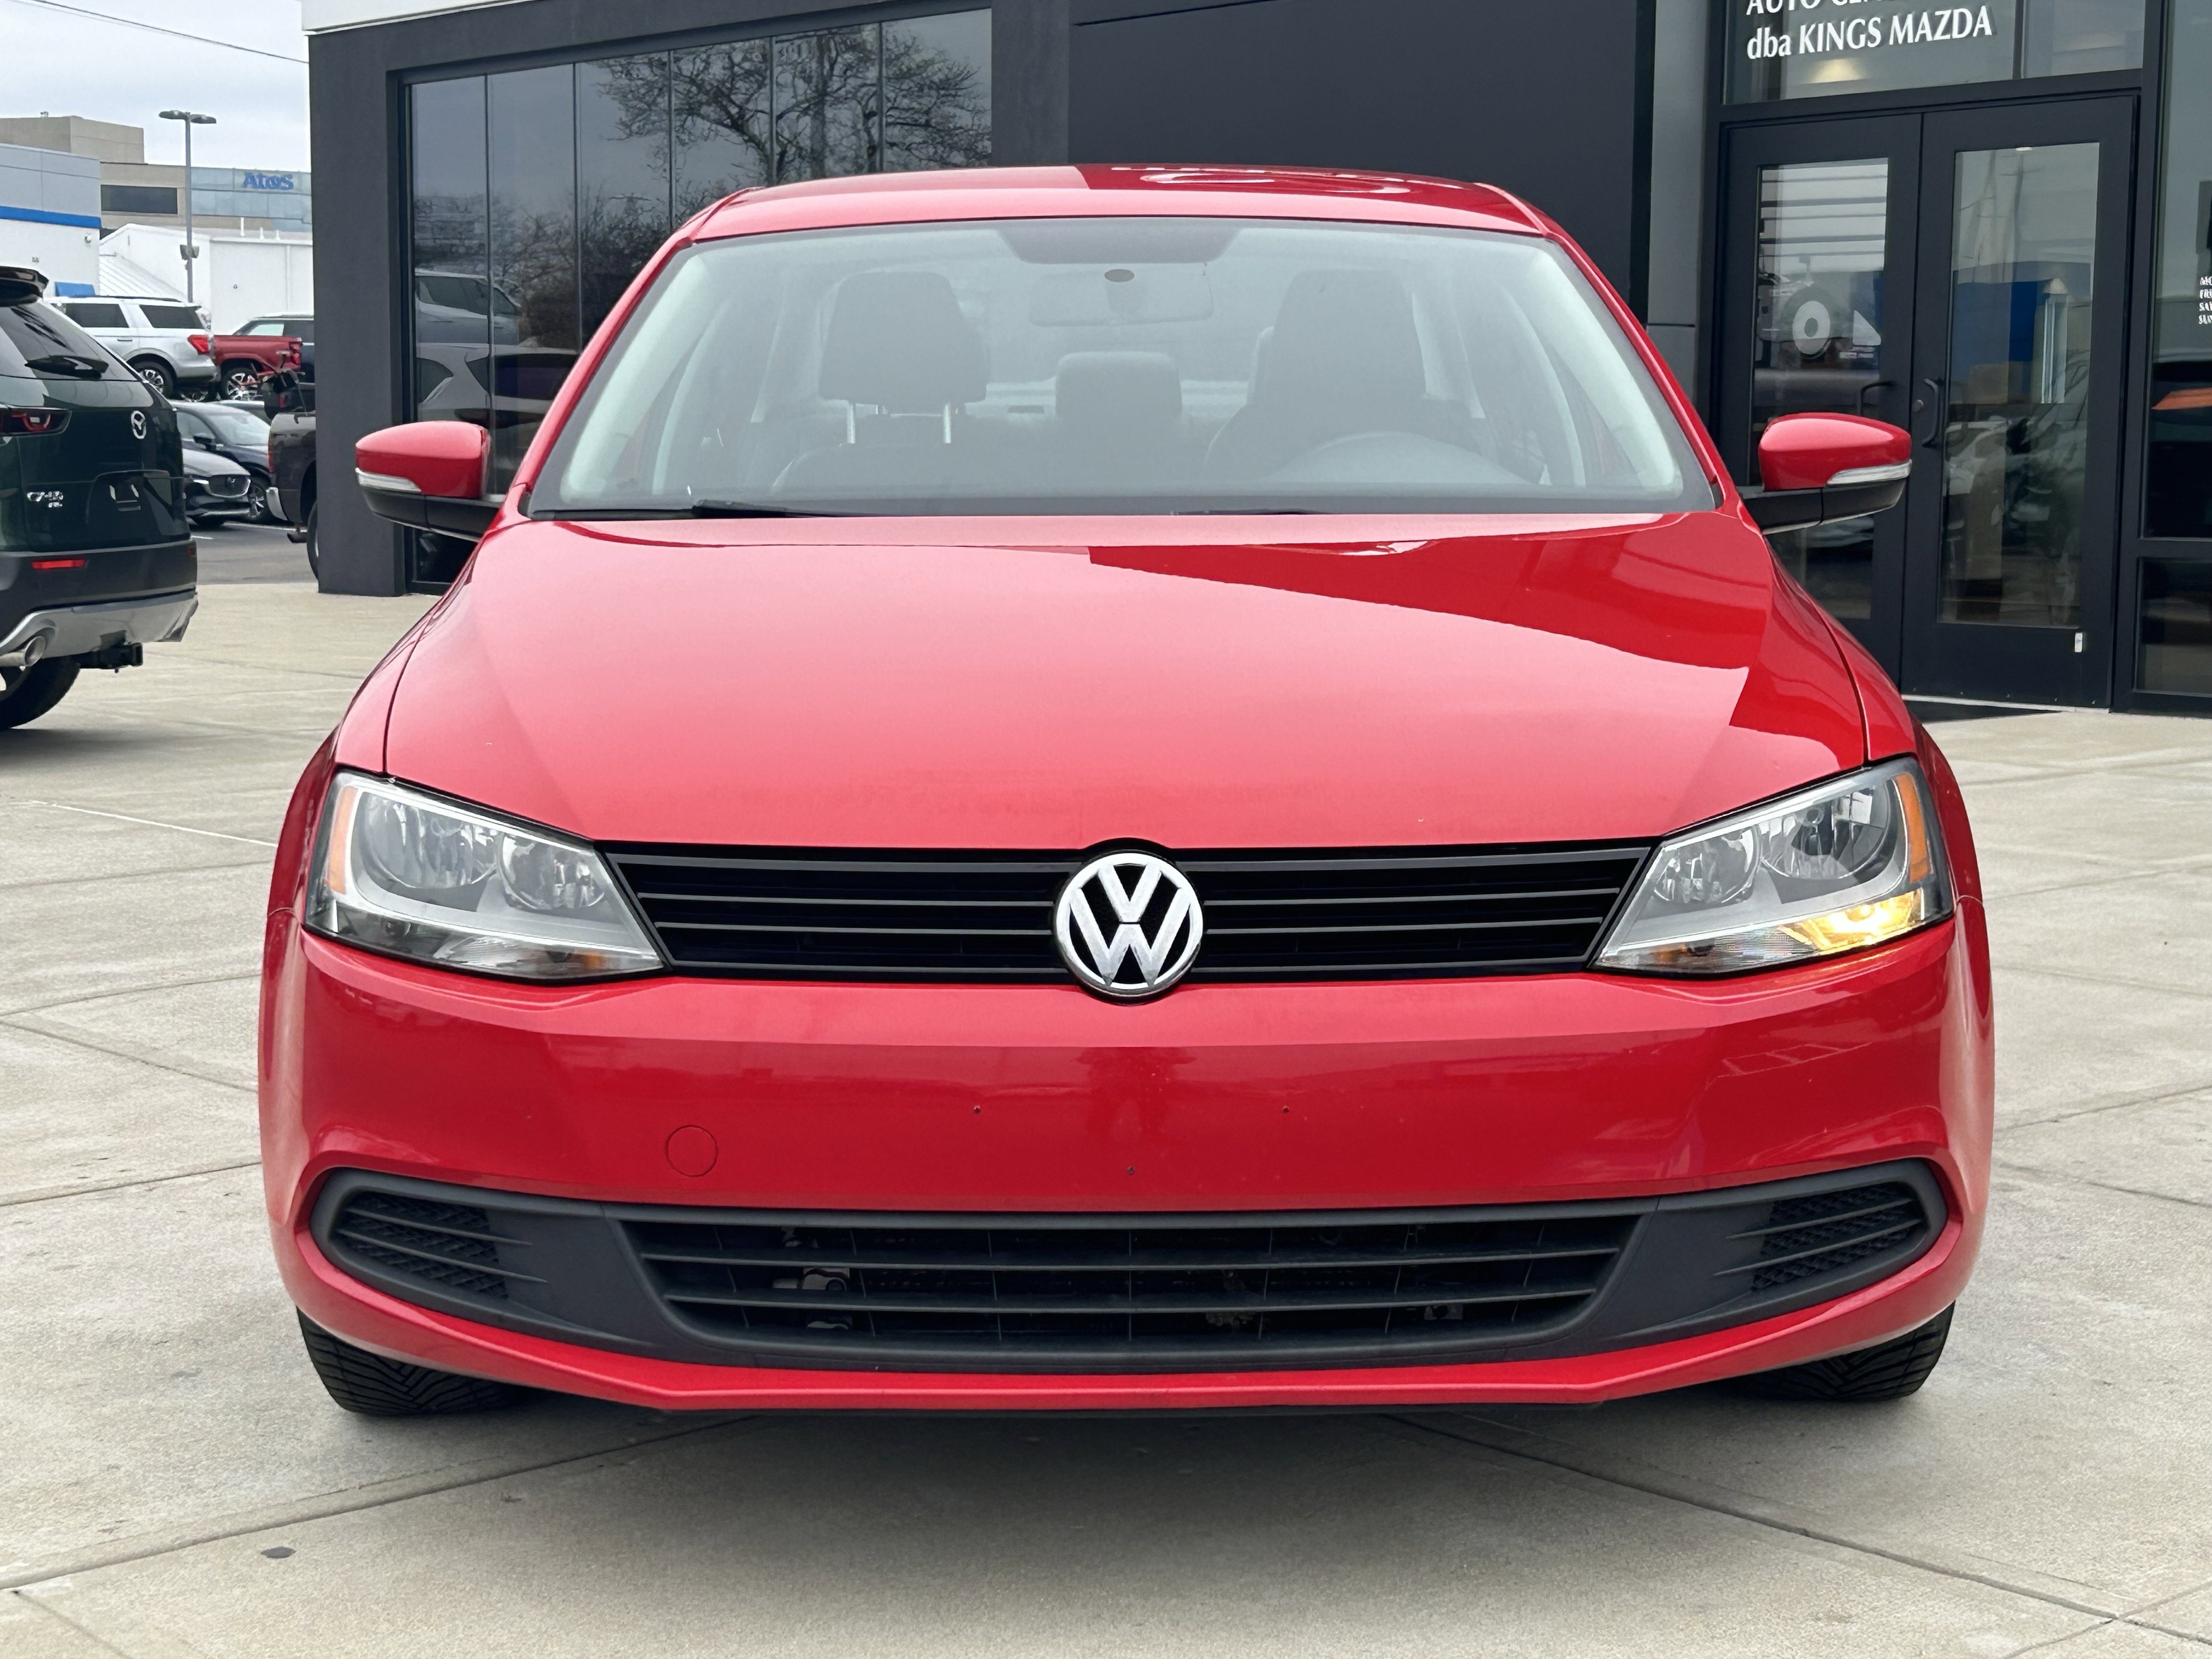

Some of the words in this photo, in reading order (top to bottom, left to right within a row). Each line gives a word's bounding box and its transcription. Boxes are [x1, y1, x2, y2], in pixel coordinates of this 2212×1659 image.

[1747, 27, 1792, 59] dba
[1798, 17, 1881, 54] KINGS
[1889, 5, 1993, 46] MAZDA
[1065, 860, 1194, 990] VW
